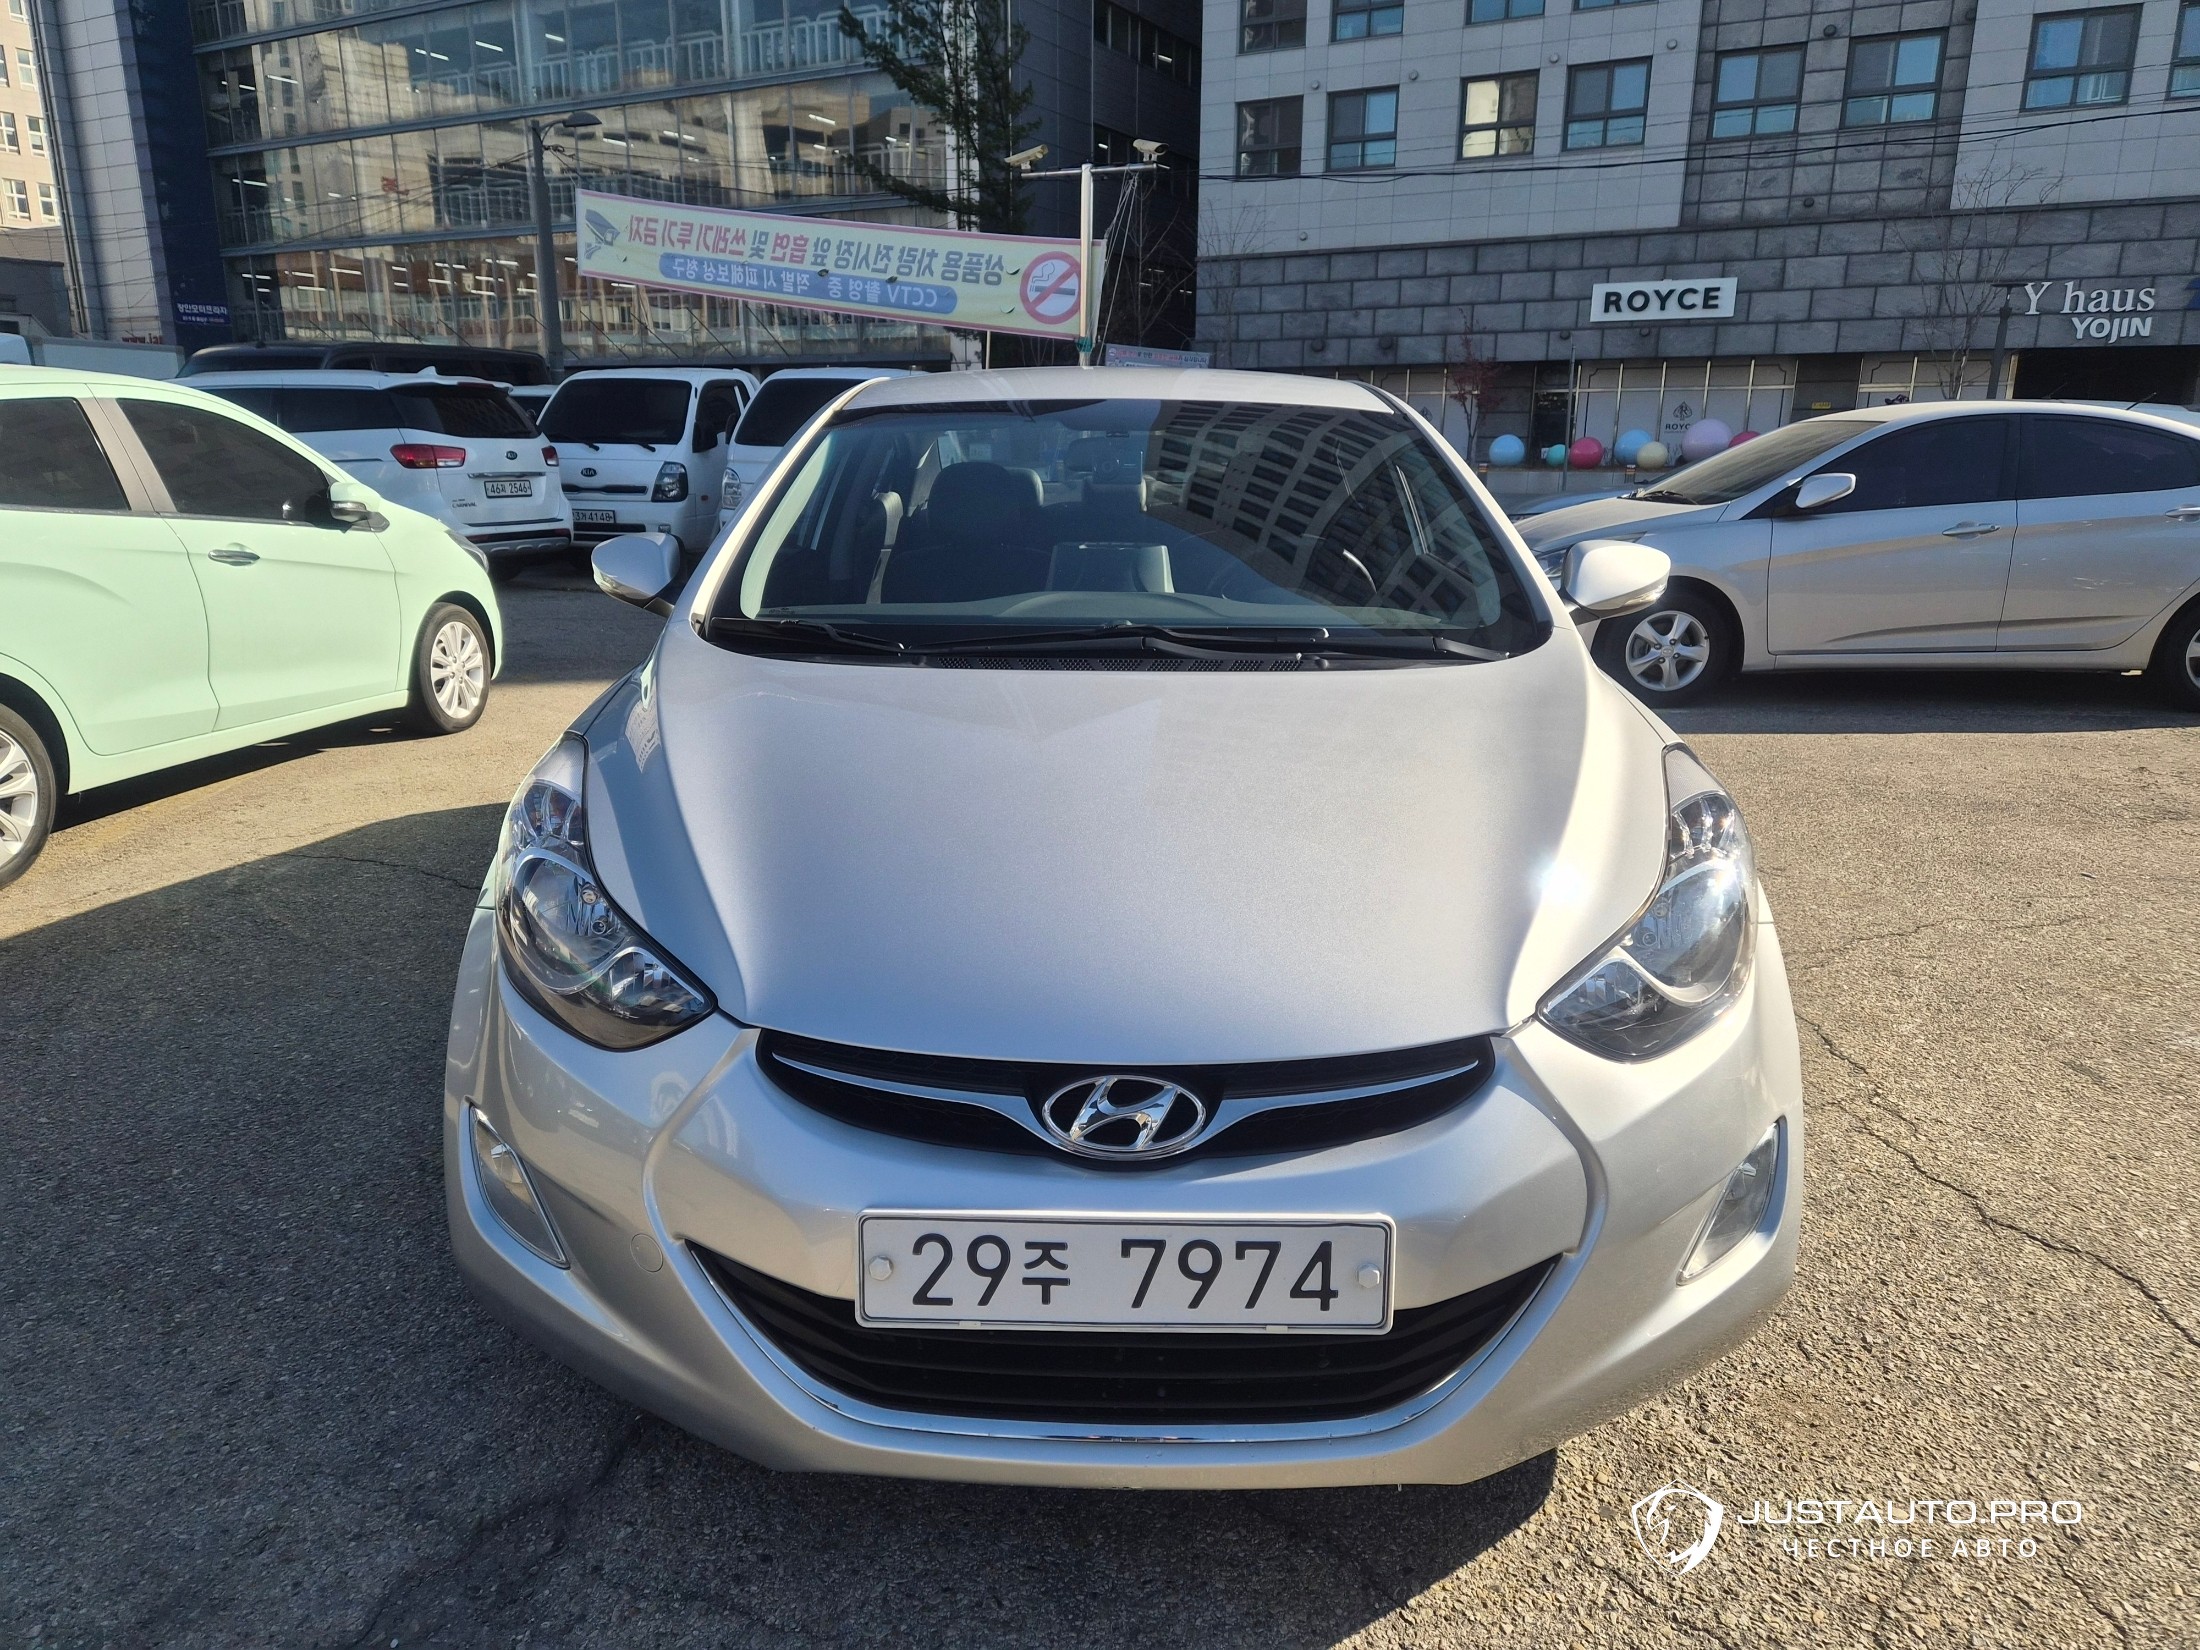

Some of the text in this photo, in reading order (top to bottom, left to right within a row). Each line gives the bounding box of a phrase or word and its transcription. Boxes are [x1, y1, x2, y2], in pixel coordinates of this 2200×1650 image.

[1603, 287, 1721, 314] ROYCE
[2024, 281, 2156, 316] Y haus
[2071, 316, 2153, 344] YOJIN
[1665, 423, 1691, 431] ROYC
[582, 468, 596, 477] KIA
[508, 482, 528, 494] 2546
[588, 511, 611, 522] 4148
[911, 1232, 1339, 1312] 29주 7974
